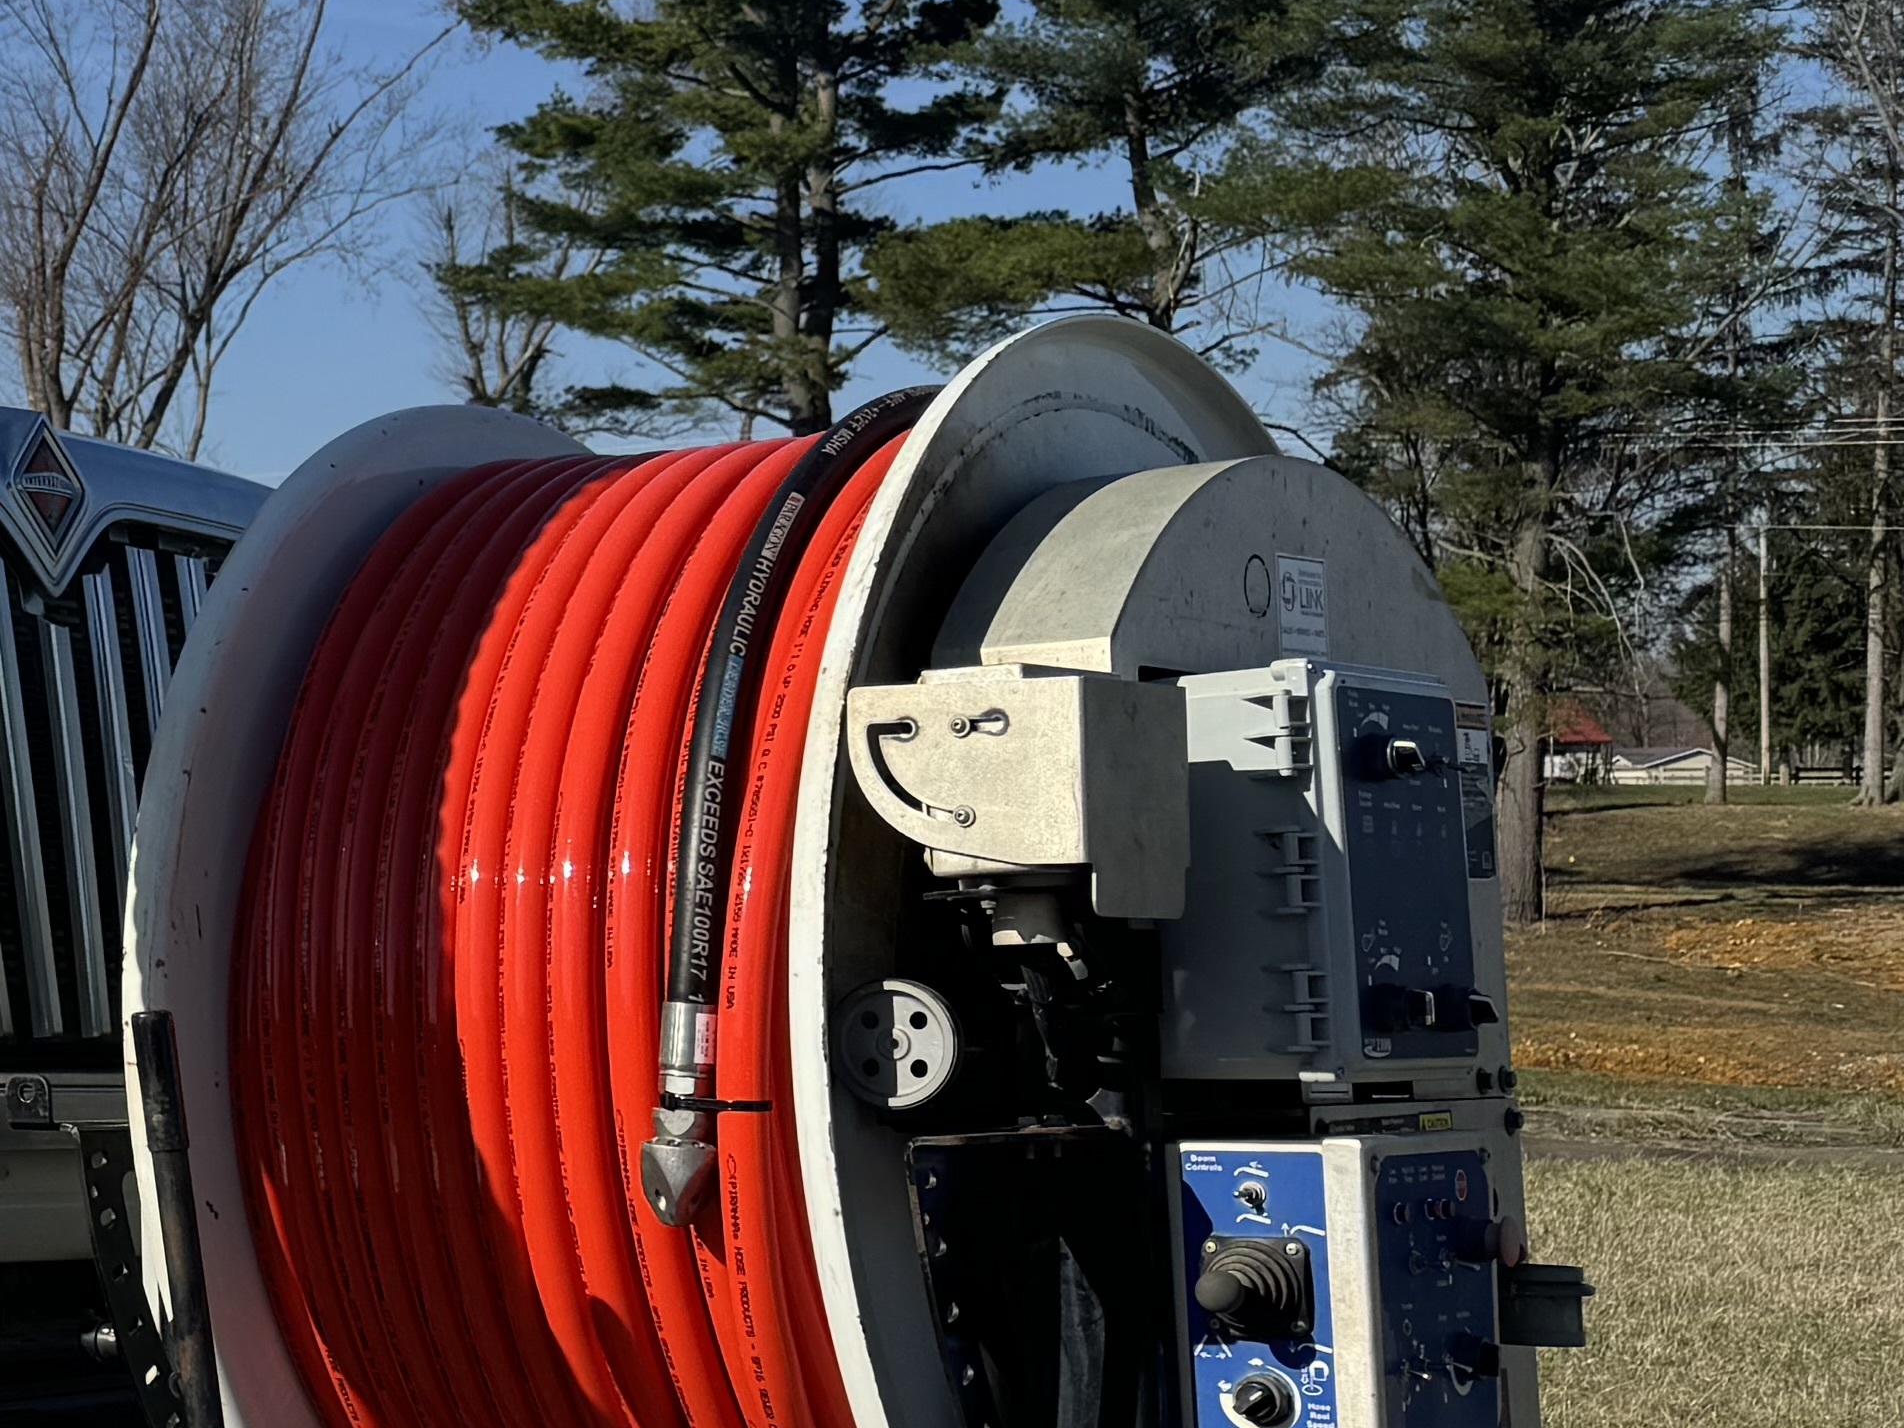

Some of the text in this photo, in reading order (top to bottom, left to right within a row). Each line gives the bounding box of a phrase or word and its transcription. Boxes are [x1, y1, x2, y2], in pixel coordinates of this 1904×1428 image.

[727, 556, 774, 656] HYDRAULIC
[1299, 588, 1324, 611] LINK
[697, 760, 725, 856] EXCEEDS
[688, 861, 715, 980] SAE100R17
[1190, 1154, 1216, 1163] Boom
[1185, 1163, 1223, 1172] Controls
[1307, 1403, 1331, 1411] Hose
[1310, 1411, 1331, 1420] Reel
